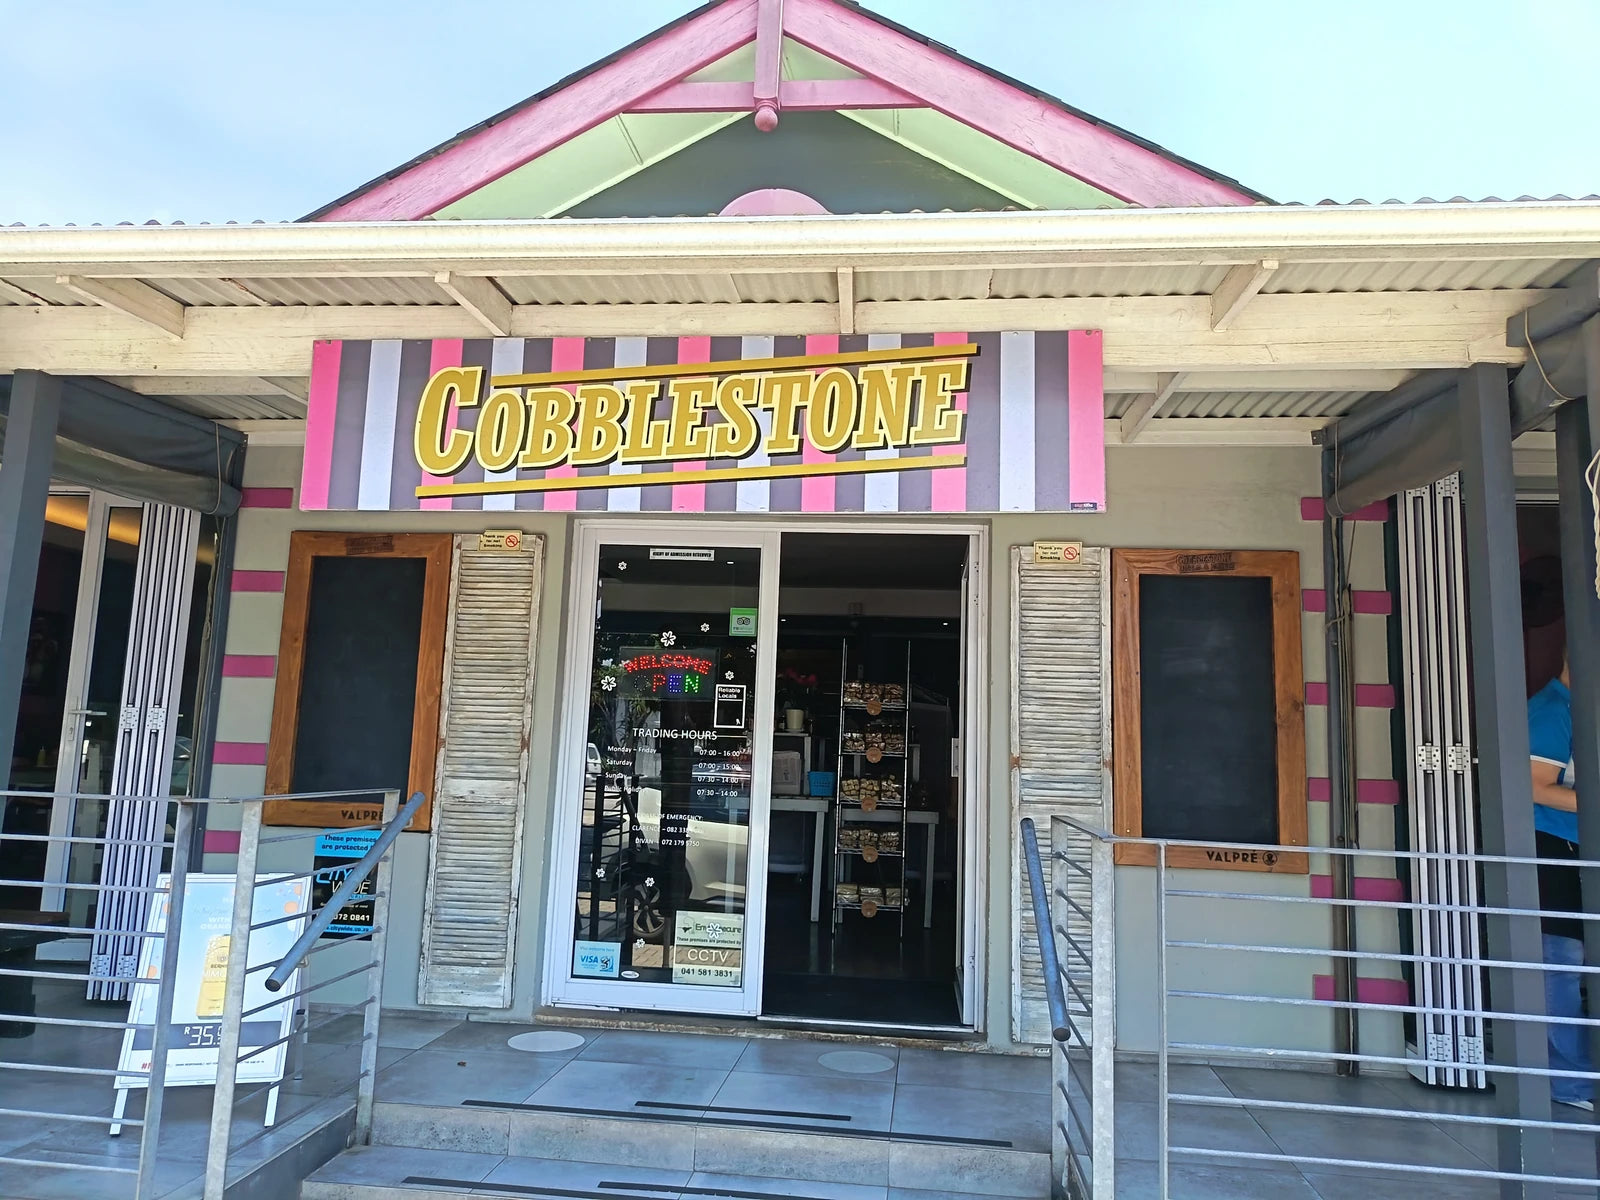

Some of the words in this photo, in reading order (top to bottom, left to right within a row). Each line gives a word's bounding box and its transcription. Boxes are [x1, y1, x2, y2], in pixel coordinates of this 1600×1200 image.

[623, 654, 712, 675] WELCOME
[633, 727, 678, 739] TRADING
[681, 729, 718, 740] HOURS
[607, 745, 632, 753] Monday
[638, 746, 657, 754] Friday
[606, 758, 633, 766] Saturday
[325, 834, 344, 842] These
[674, 839, 685, 847] 179
[580, 955, 599, 964] VISA
[687, 948, 729, 963] CCTV
[681, 967, 695, 975] 041
[697, 968, 712, 976] 581
[714, 969, 733, 978] 3831
